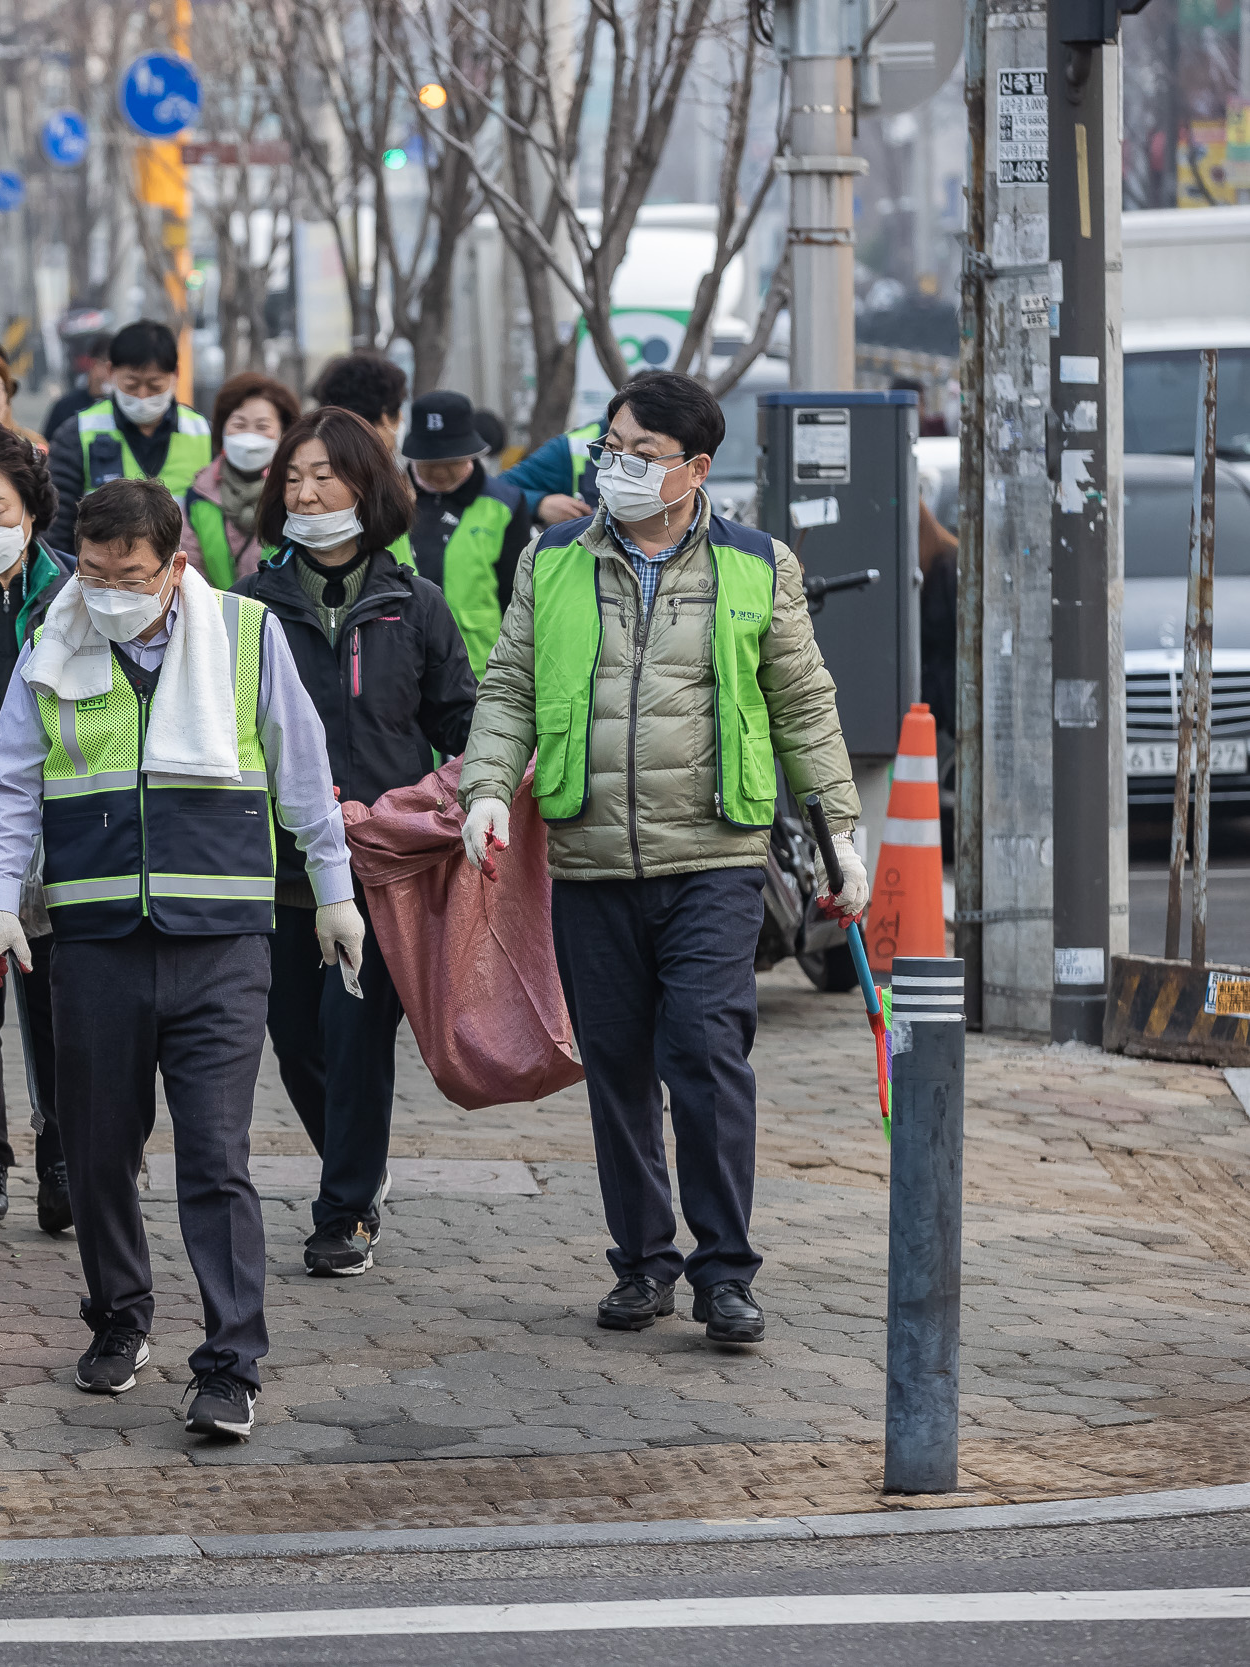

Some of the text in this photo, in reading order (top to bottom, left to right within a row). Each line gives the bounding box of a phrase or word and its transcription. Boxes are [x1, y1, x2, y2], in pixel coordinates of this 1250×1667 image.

[999, 73, 1046, 95] 신축빌
[426, 412, 445, 431] B
[738, 610, 762, 620] 광진구
[80, 698, 103, 708] 광진구
